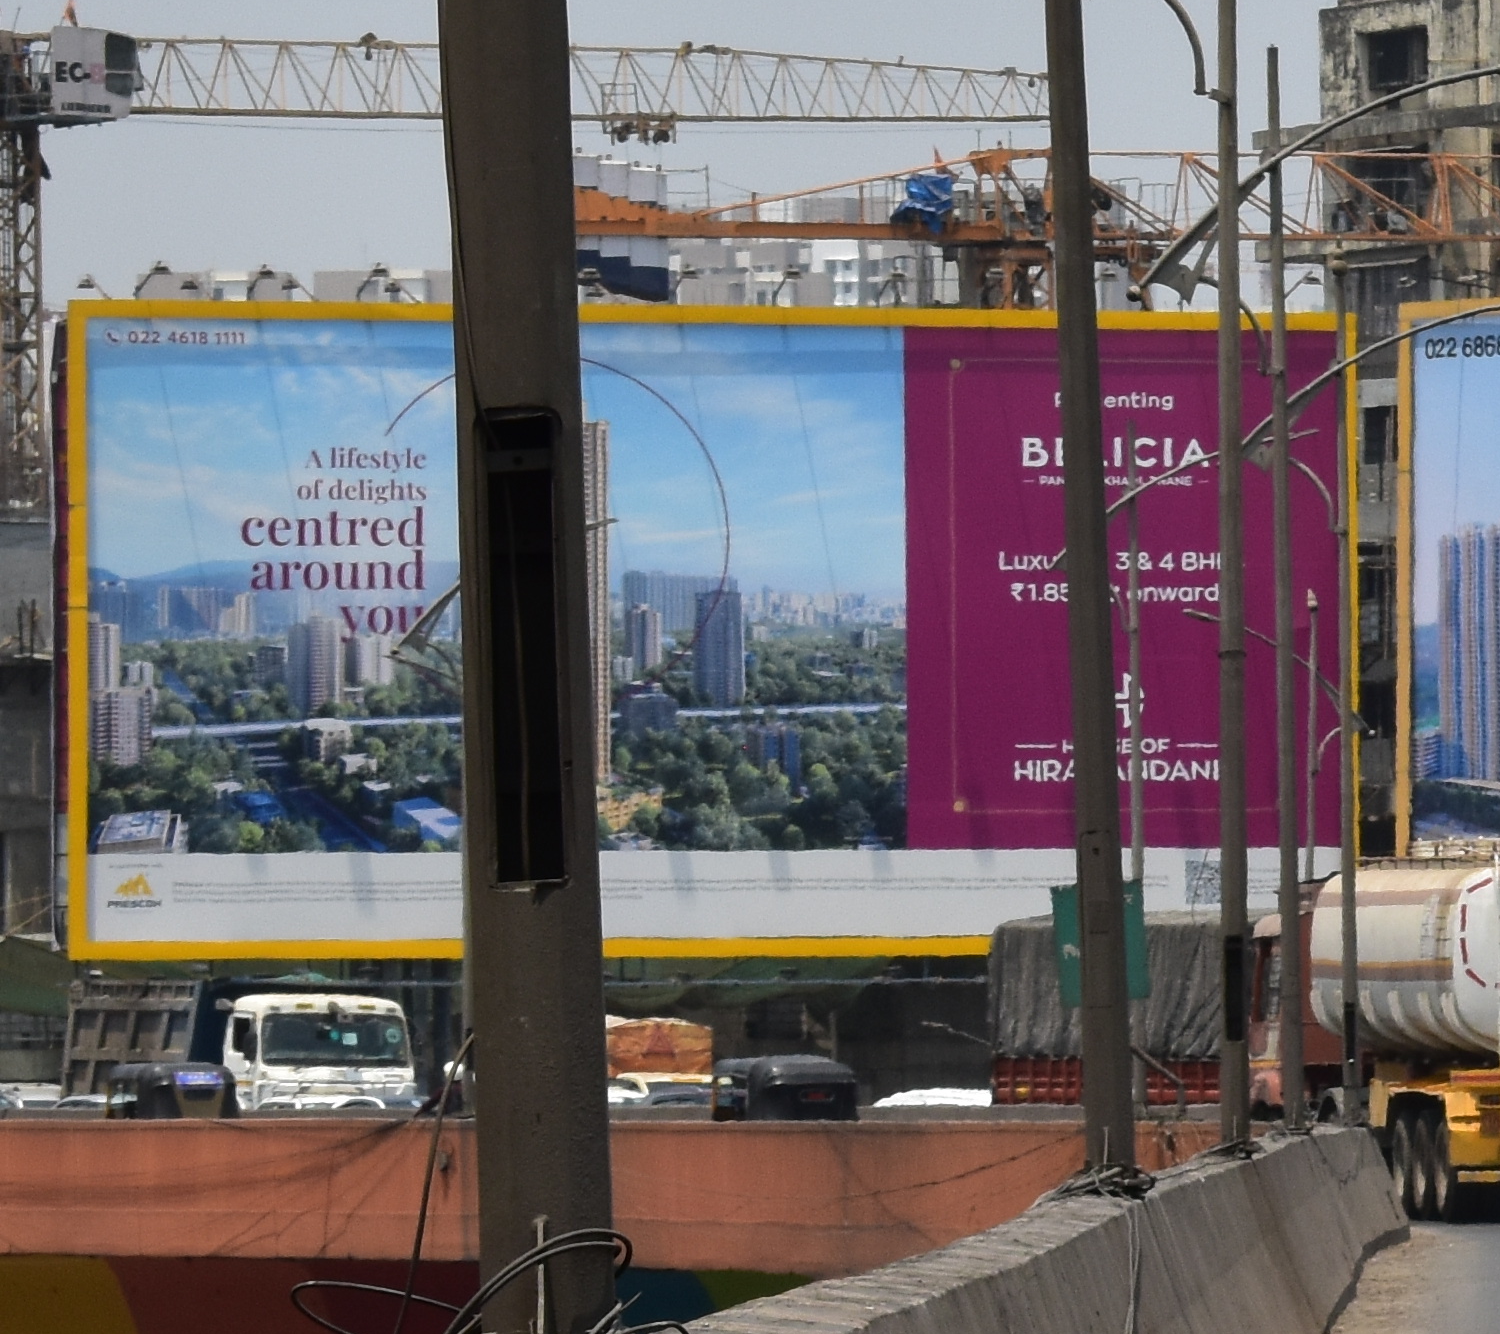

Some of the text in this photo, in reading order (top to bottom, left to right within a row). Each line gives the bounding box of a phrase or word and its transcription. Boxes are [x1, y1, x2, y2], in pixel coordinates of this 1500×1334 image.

[128, 330, 246, 345] 022 4618 1111
[1425, 337, 1457, 359] 022
[1054, 391, 1175, 411] Penting
[305, 447, 427, 473] A lifestyle
[1021, 436, 1210, 468] BICIA
[297, 479, 427, 505] of delights
[240, 505, 427, 547] centred
[250, 549, 427, 590] around
[1115, 552, 1175, 571] 3 & 4
